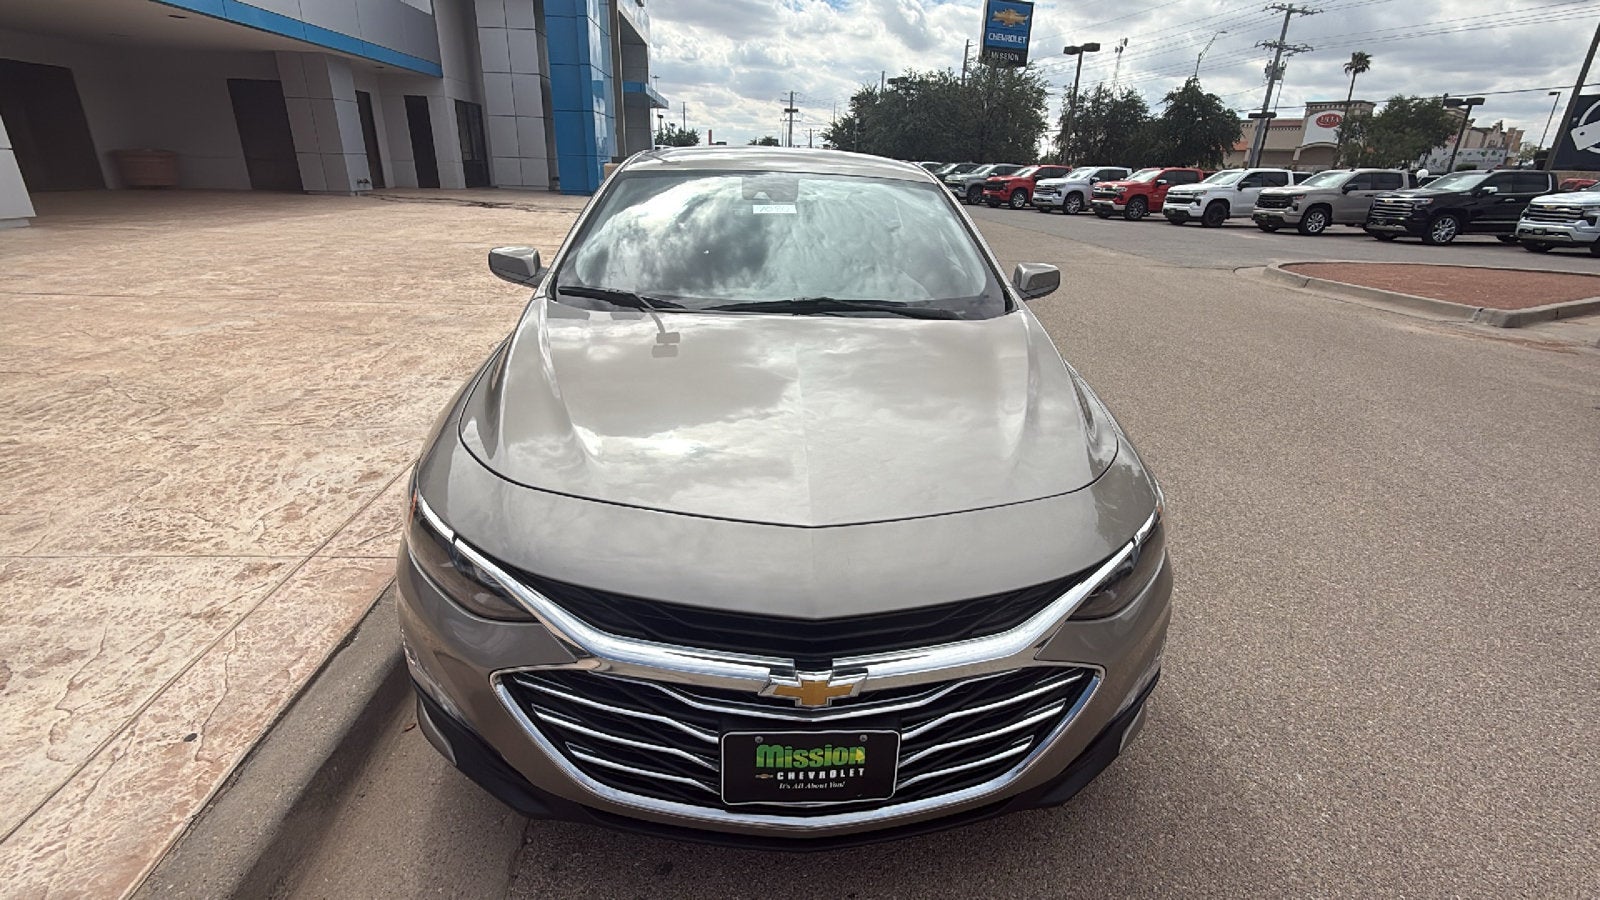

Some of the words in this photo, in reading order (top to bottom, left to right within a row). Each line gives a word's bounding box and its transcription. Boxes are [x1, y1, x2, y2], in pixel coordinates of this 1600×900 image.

[988, 32, 1027, 44] CHEVROLET
[991, 51, 1019, 61] MISSION
[776, 768, 865, 780] CHEVROLET
